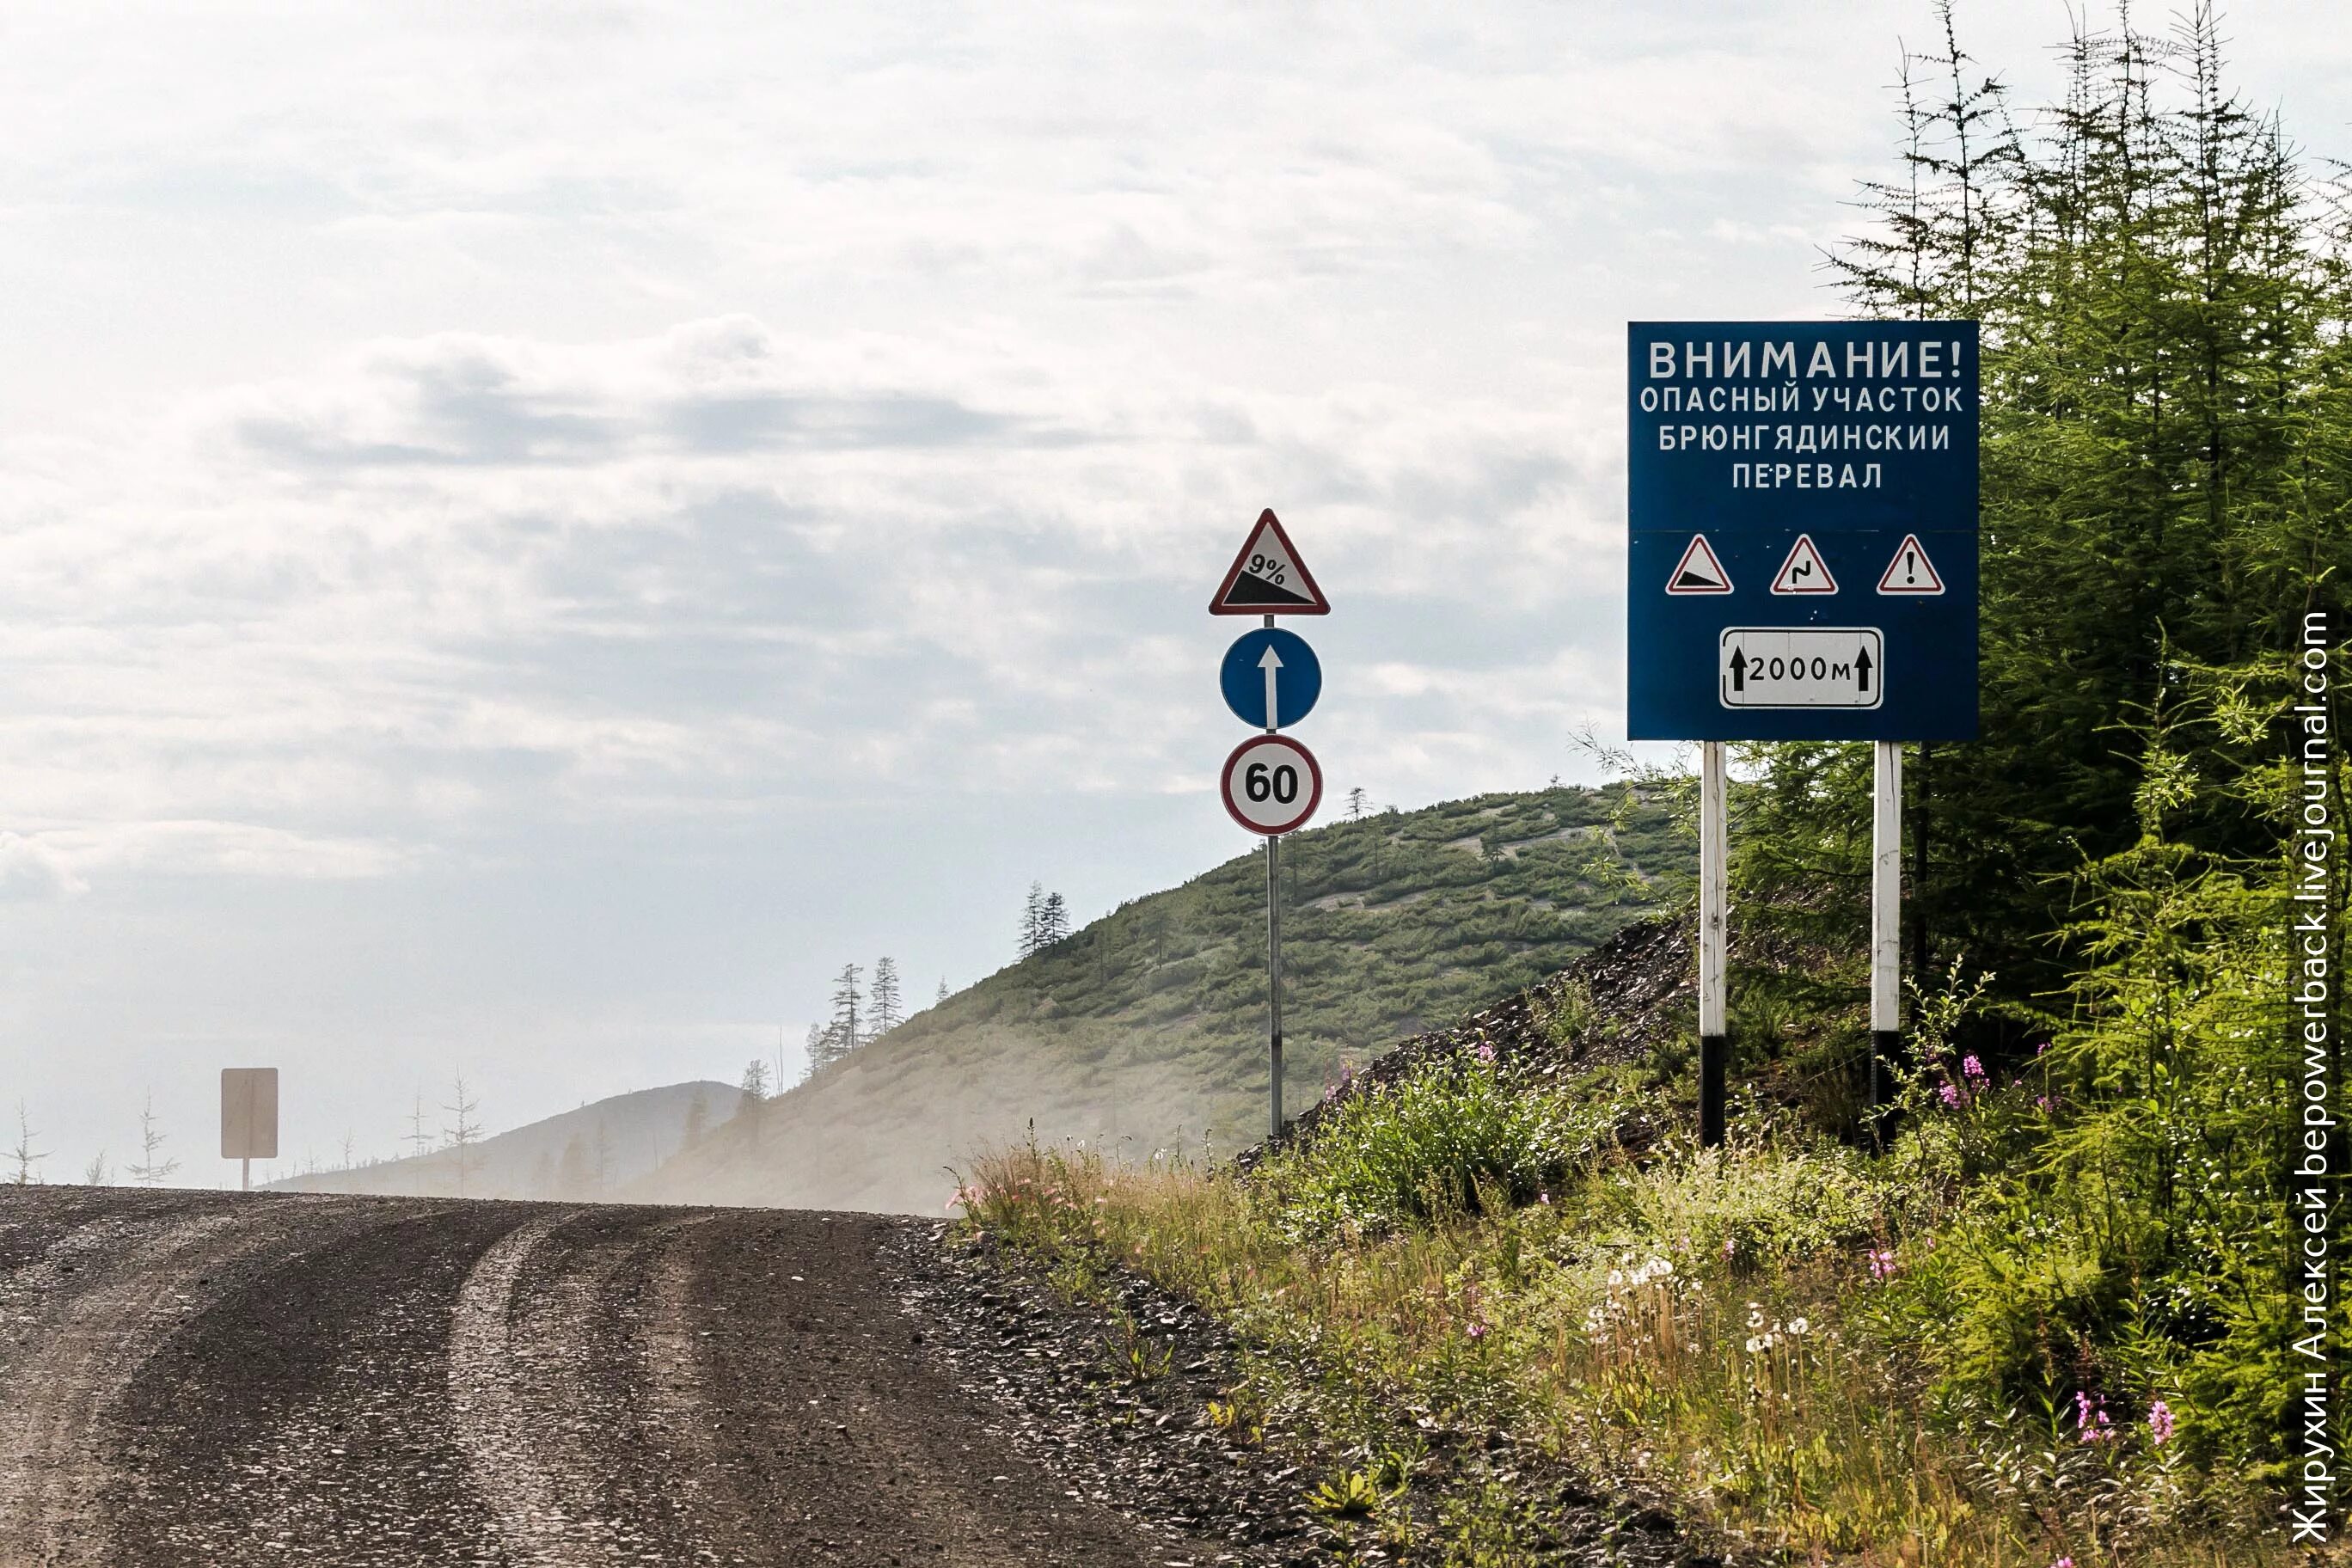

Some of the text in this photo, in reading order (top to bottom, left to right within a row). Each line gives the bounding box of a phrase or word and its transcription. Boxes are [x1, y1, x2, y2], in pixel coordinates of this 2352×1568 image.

[1650, 341, 1961, 378] ВНИМАНИЕ!
[1640, 381, 1963, 413] ОПАСНЫЙ УЧАСТОК
[1733, 463, 1881, 488] ПЕРЕВАЛ
[1248, 554, 1287, 585] 9%
[1246, 763, 1299, 804] 60
